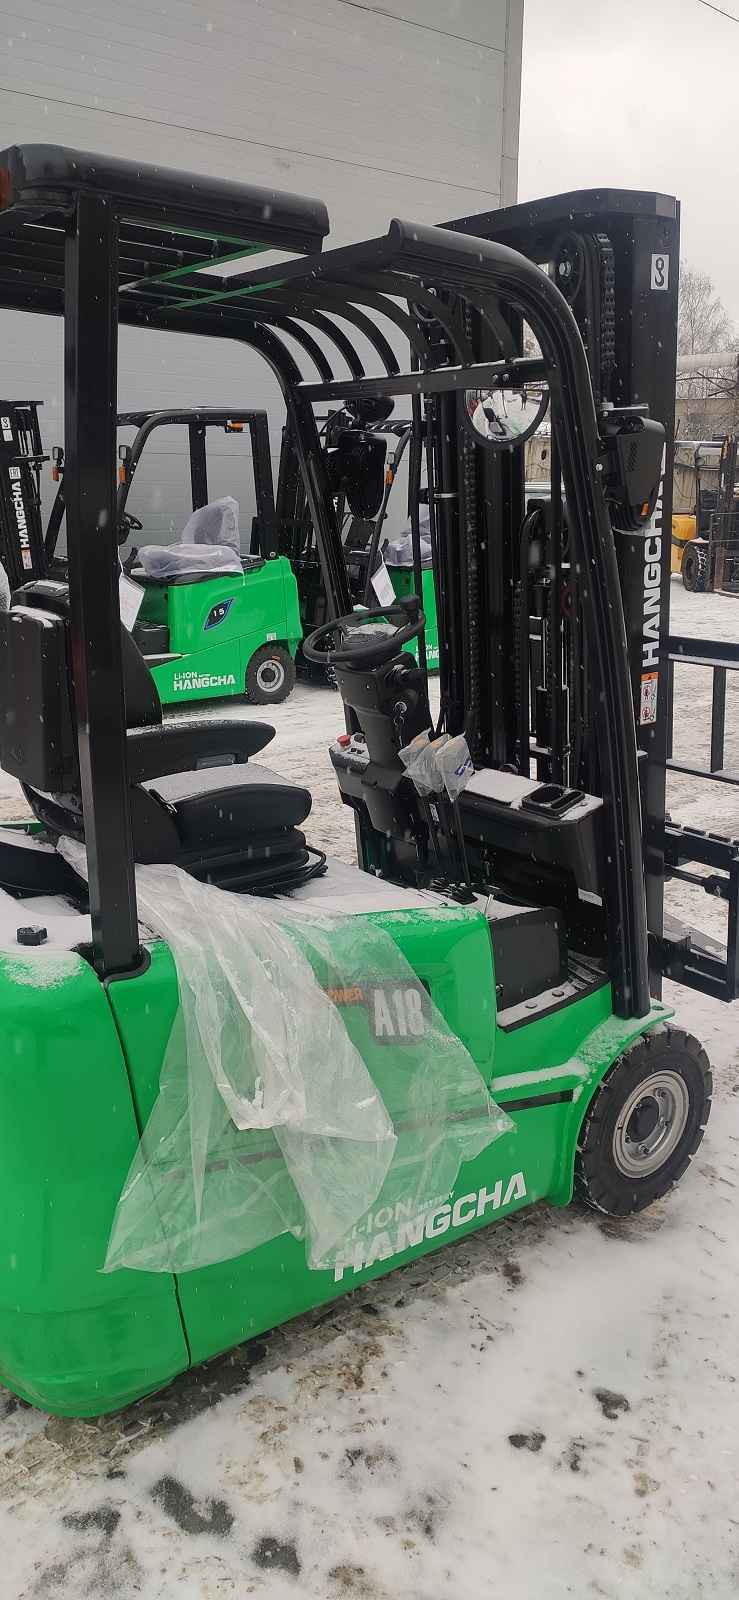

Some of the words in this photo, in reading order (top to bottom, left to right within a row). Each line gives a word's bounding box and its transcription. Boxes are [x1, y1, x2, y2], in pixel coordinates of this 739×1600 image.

[12, 481, 30, 548] HANGCHA
[173, 674, 236, 691] HANGCHA
[374, 988, 425, 1037] A18
[334, 1171, 527, 1282] HANGCHA
